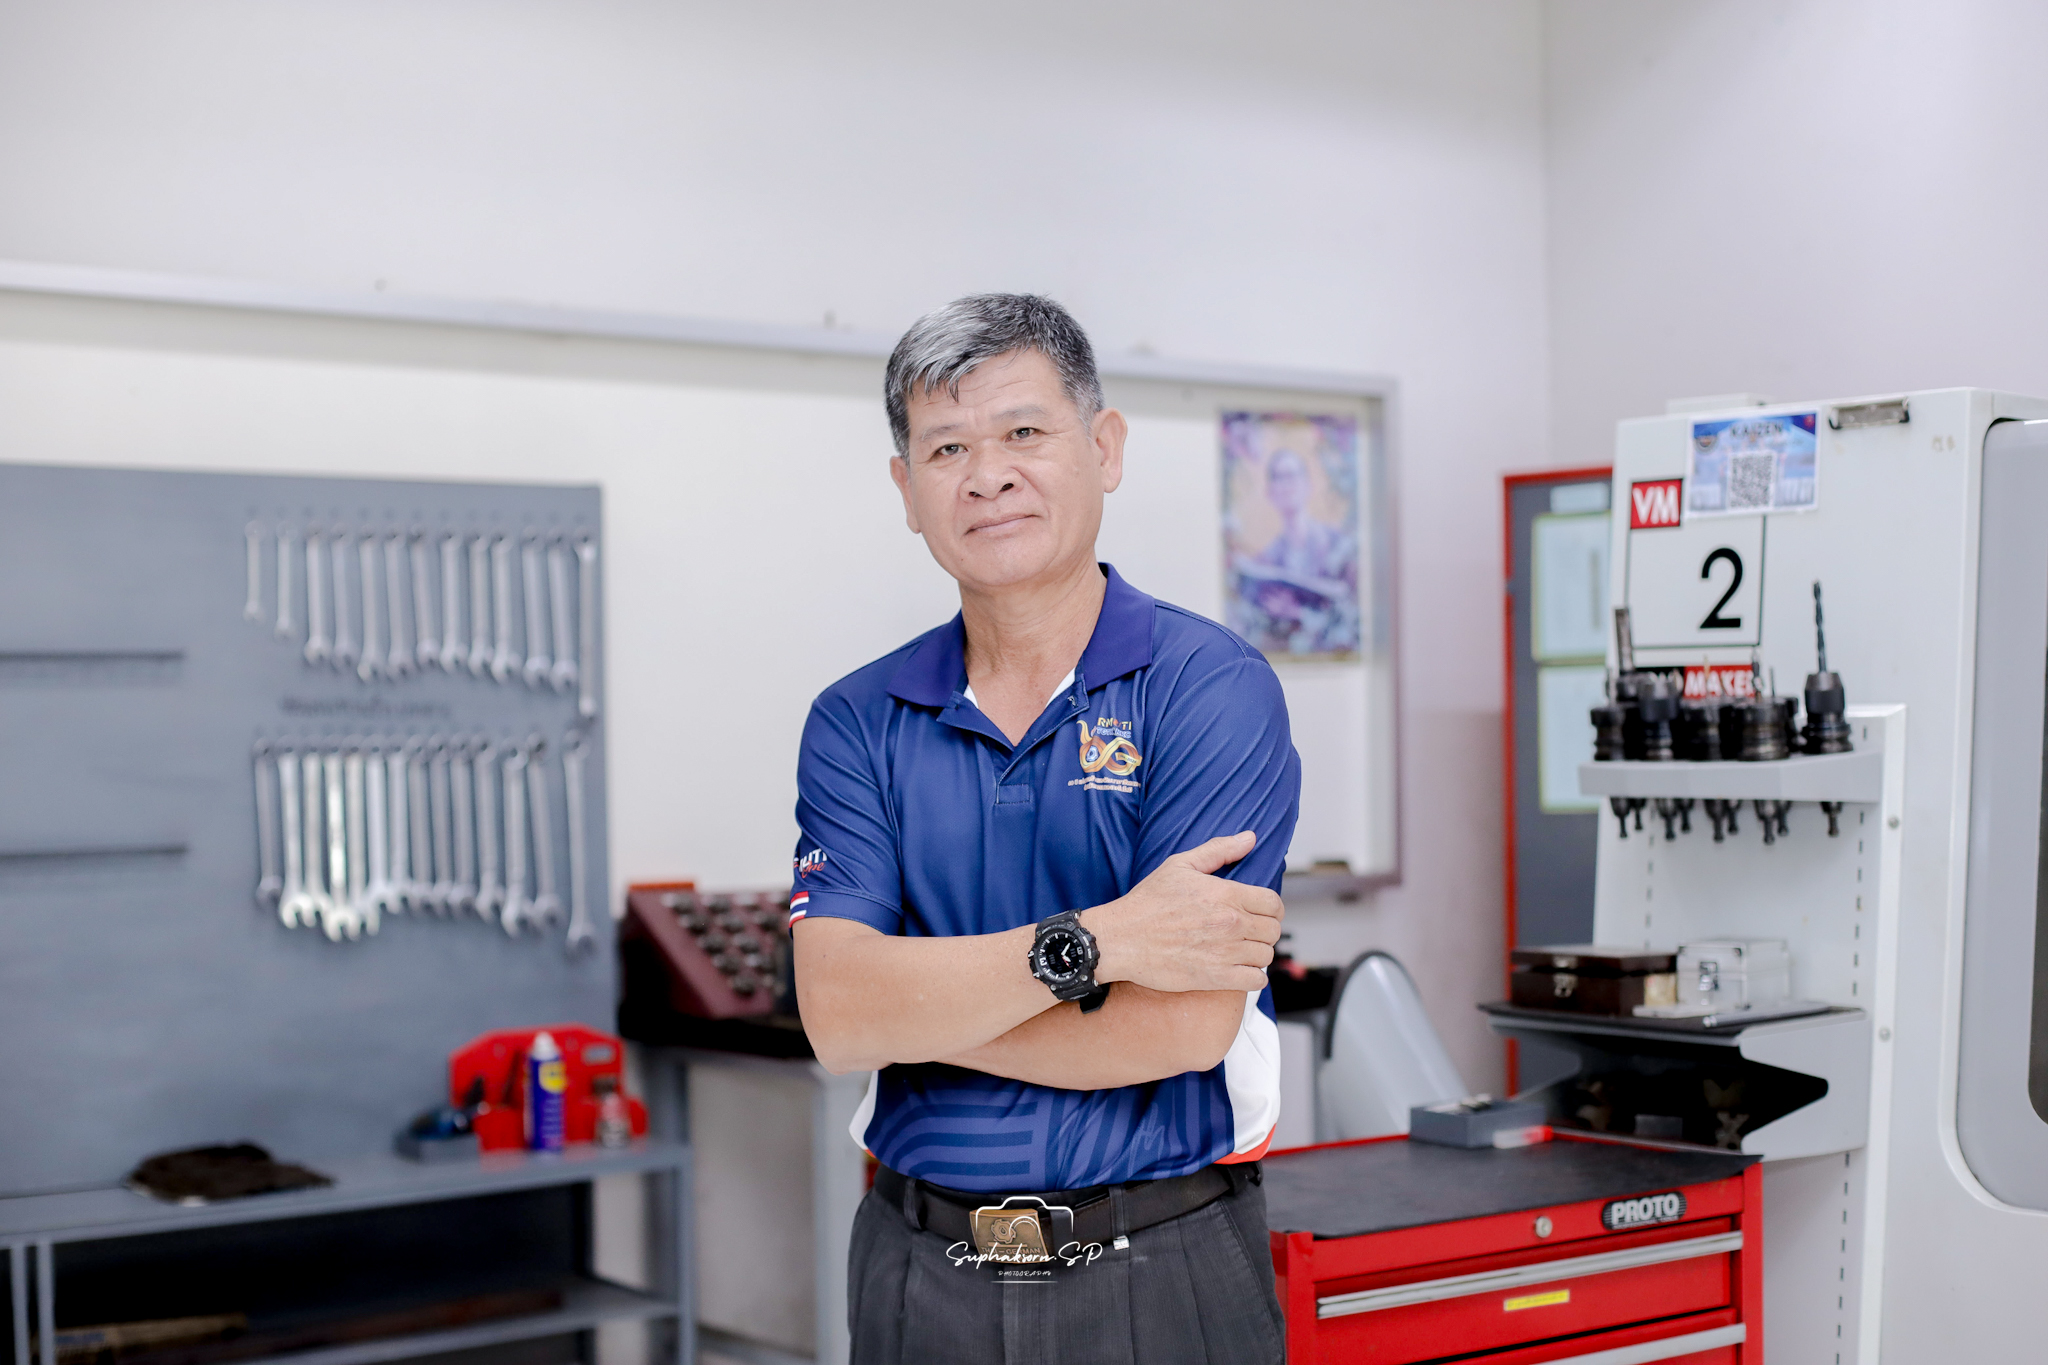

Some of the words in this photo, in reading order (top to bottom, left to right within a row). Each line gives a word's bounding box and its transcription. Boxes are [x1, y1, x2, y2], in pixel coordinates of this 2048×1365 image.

[1633, 487, 1679, 525] VM
[1700, 548, 1743, 629] 2
[1612, 1193, 1679, 1224] PROTO
